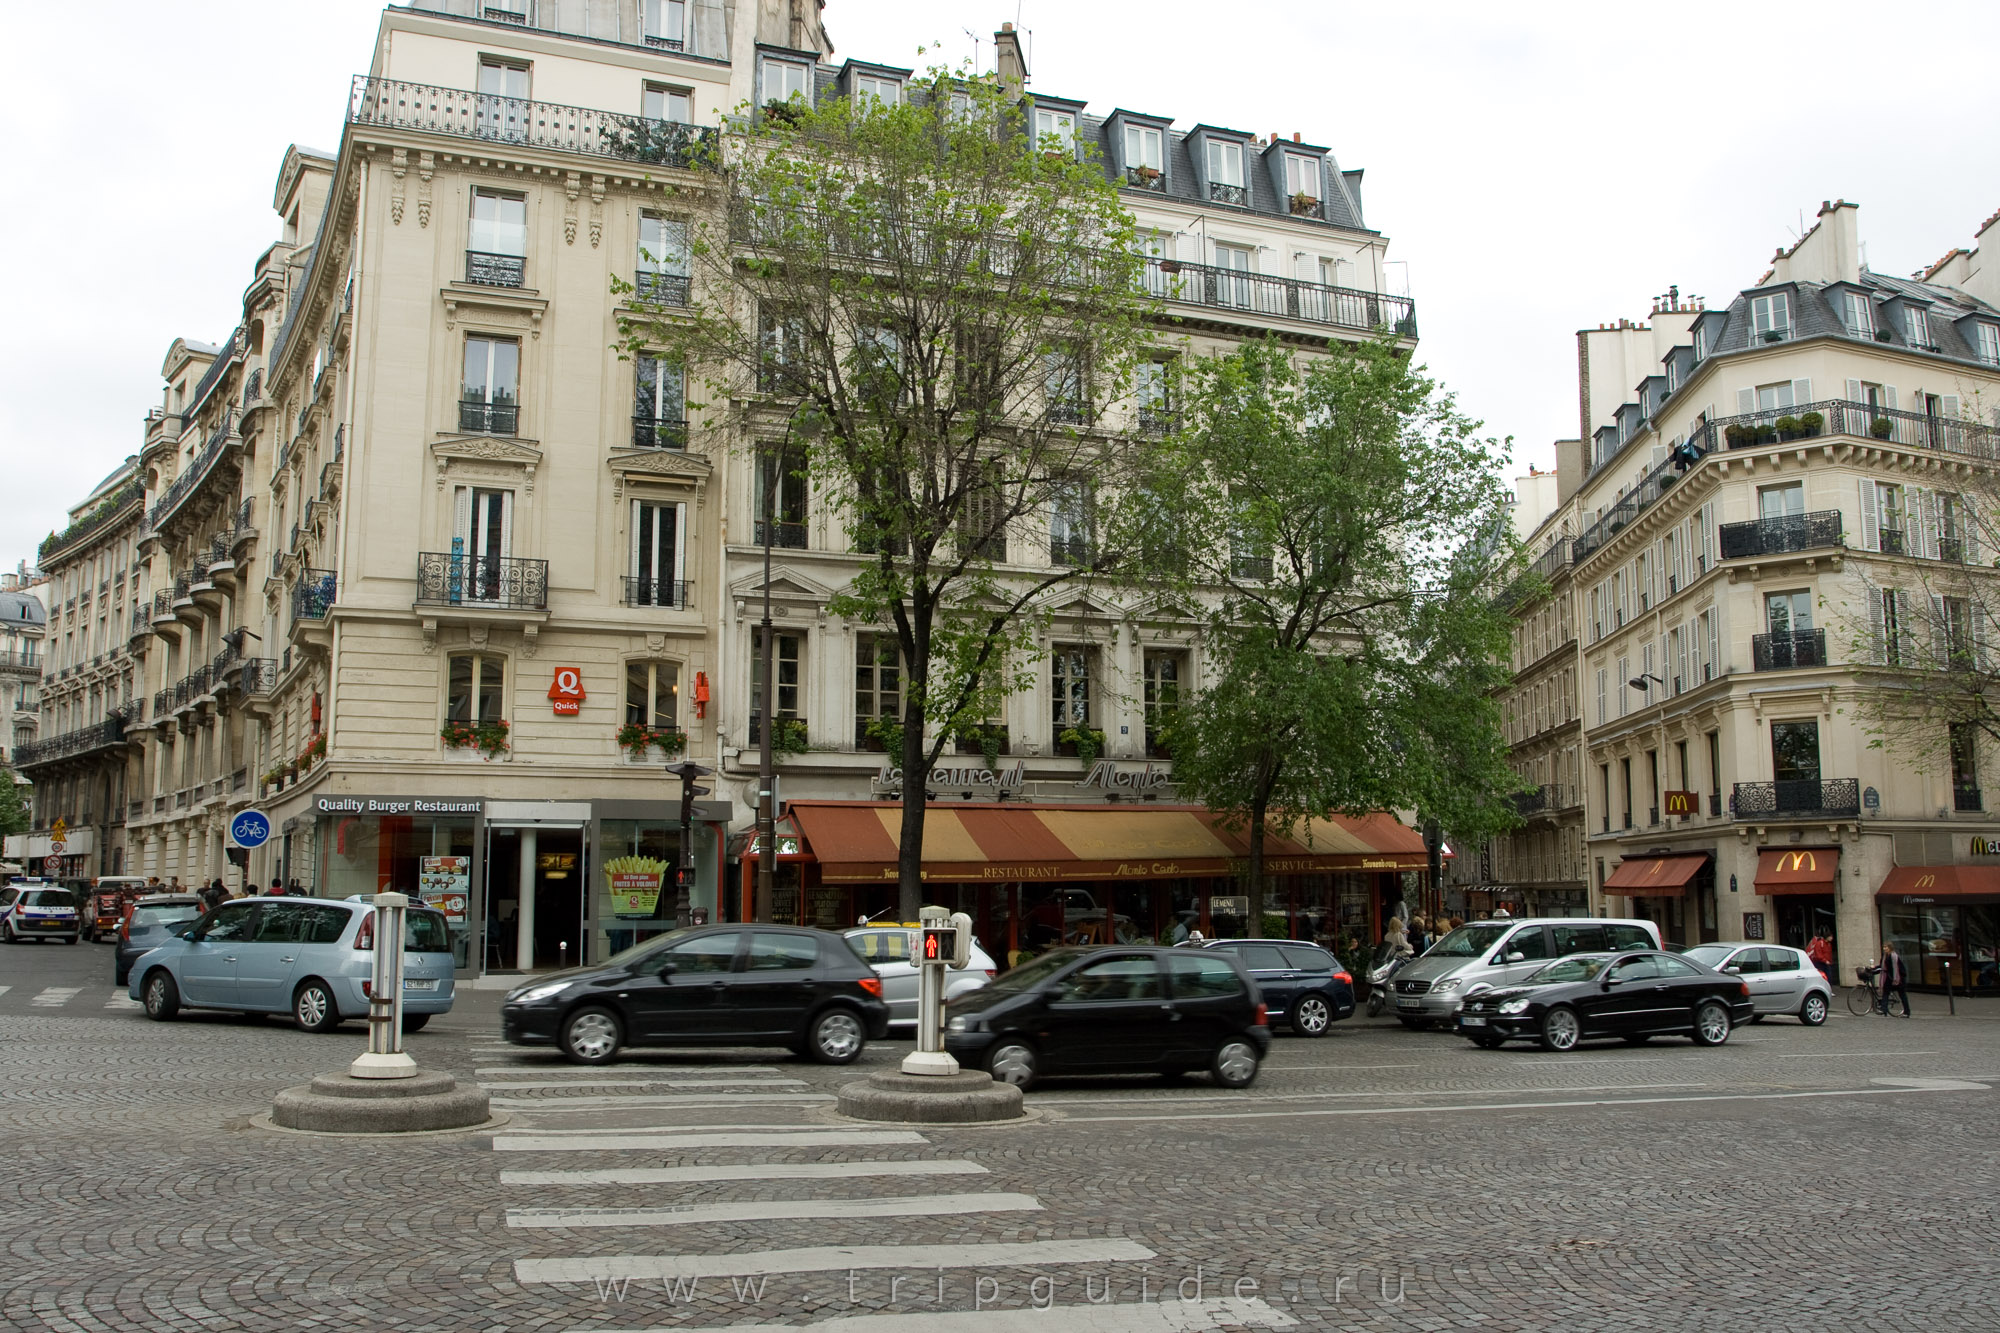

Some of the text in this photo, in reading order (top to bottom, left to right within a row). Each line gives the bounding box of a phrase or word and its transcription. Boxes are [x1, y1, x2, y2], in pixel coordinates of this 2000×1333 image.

[558, 671, 579, 695] Q
[555, 702, 578, 710] Quick
[318, 798, 480, 813] Quality Burger Restaurant
[984, 867, 1060, 878] RESTAURANT
[1113, 864, 1148, 875] Monte
[1152, 863, 1180, 874] Carlo
